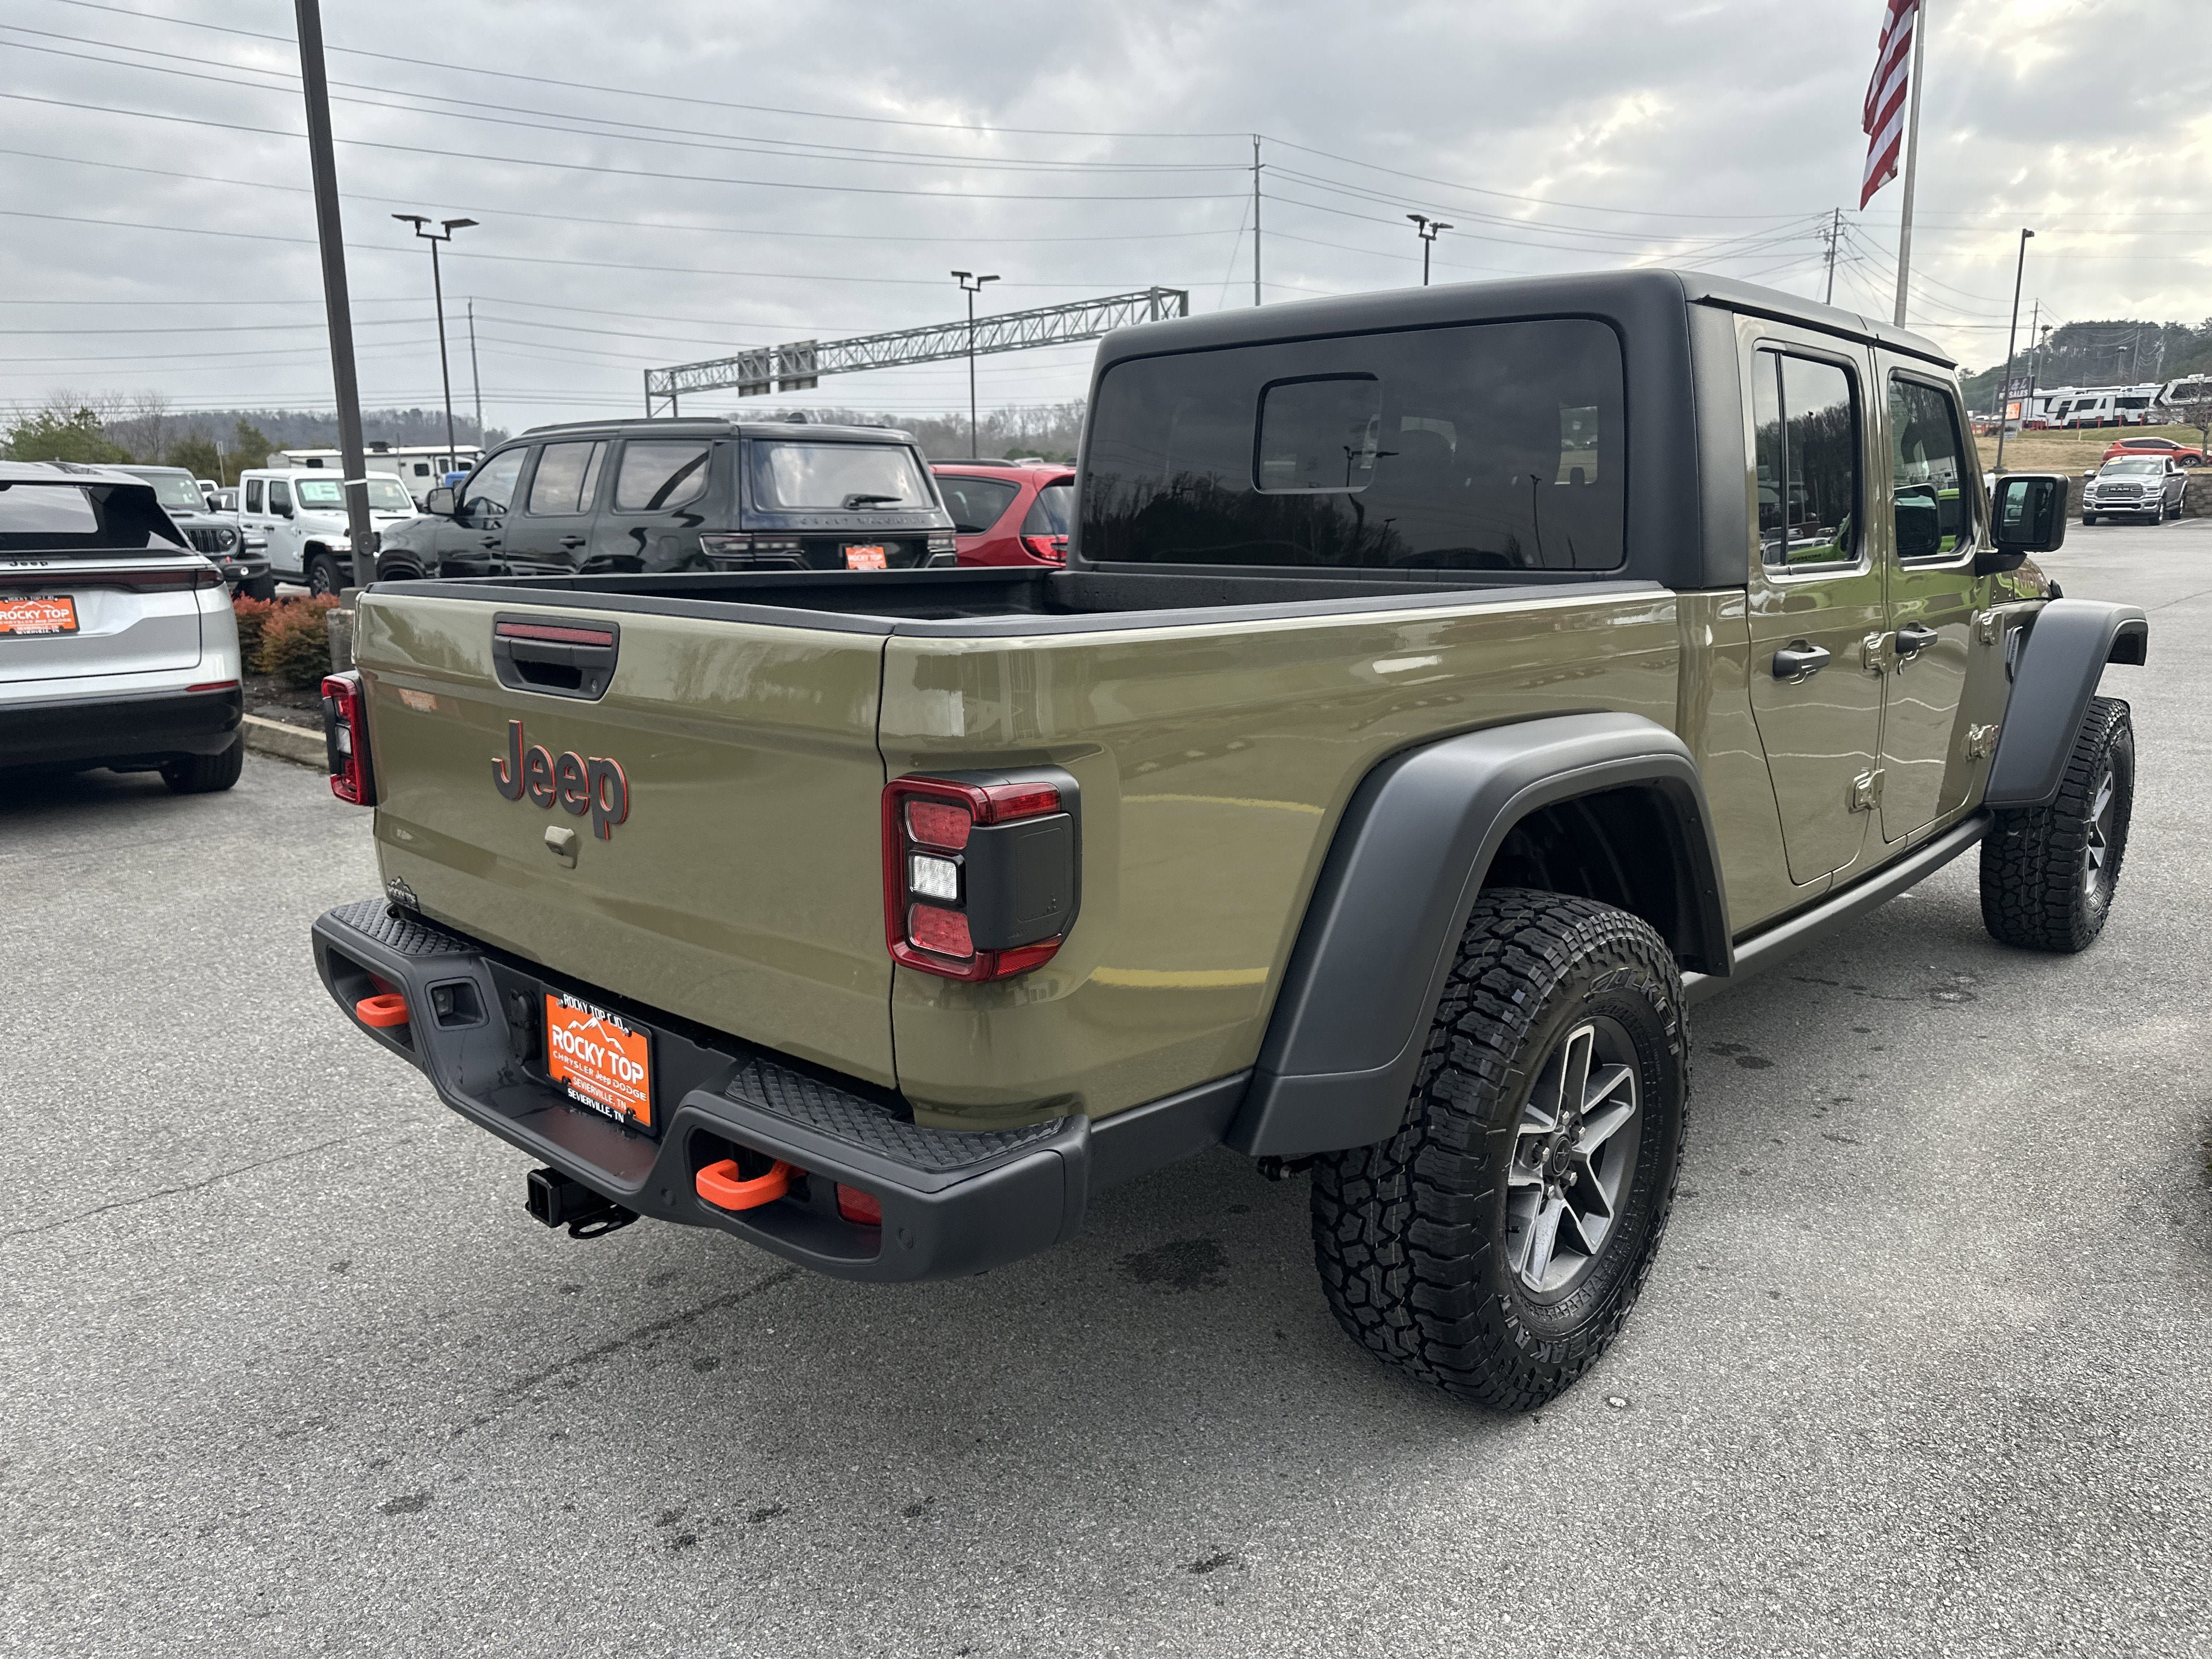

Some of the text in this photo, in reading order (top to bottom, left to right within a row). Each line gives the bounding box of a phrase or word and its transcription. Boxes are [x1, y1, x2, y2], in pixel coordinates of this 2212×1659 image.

[2008, 389, 2028, 398] SALES
[0, 608, 70, 620] ROCKY TOP
[491, 719, 628, 840] Jeep
[563, 994, 624, 1030] ROCKY TOP CJD
[552, 1024, 644, 1085] ROCKY TOP
[552, 1050, 647, 1102] CHRYSLER Jeep DODGE
[572, 1076, 627, 1110] SEVIERVILLE, TN
[567, 1088, 624, 1123] SEVIERVILLE, TN
